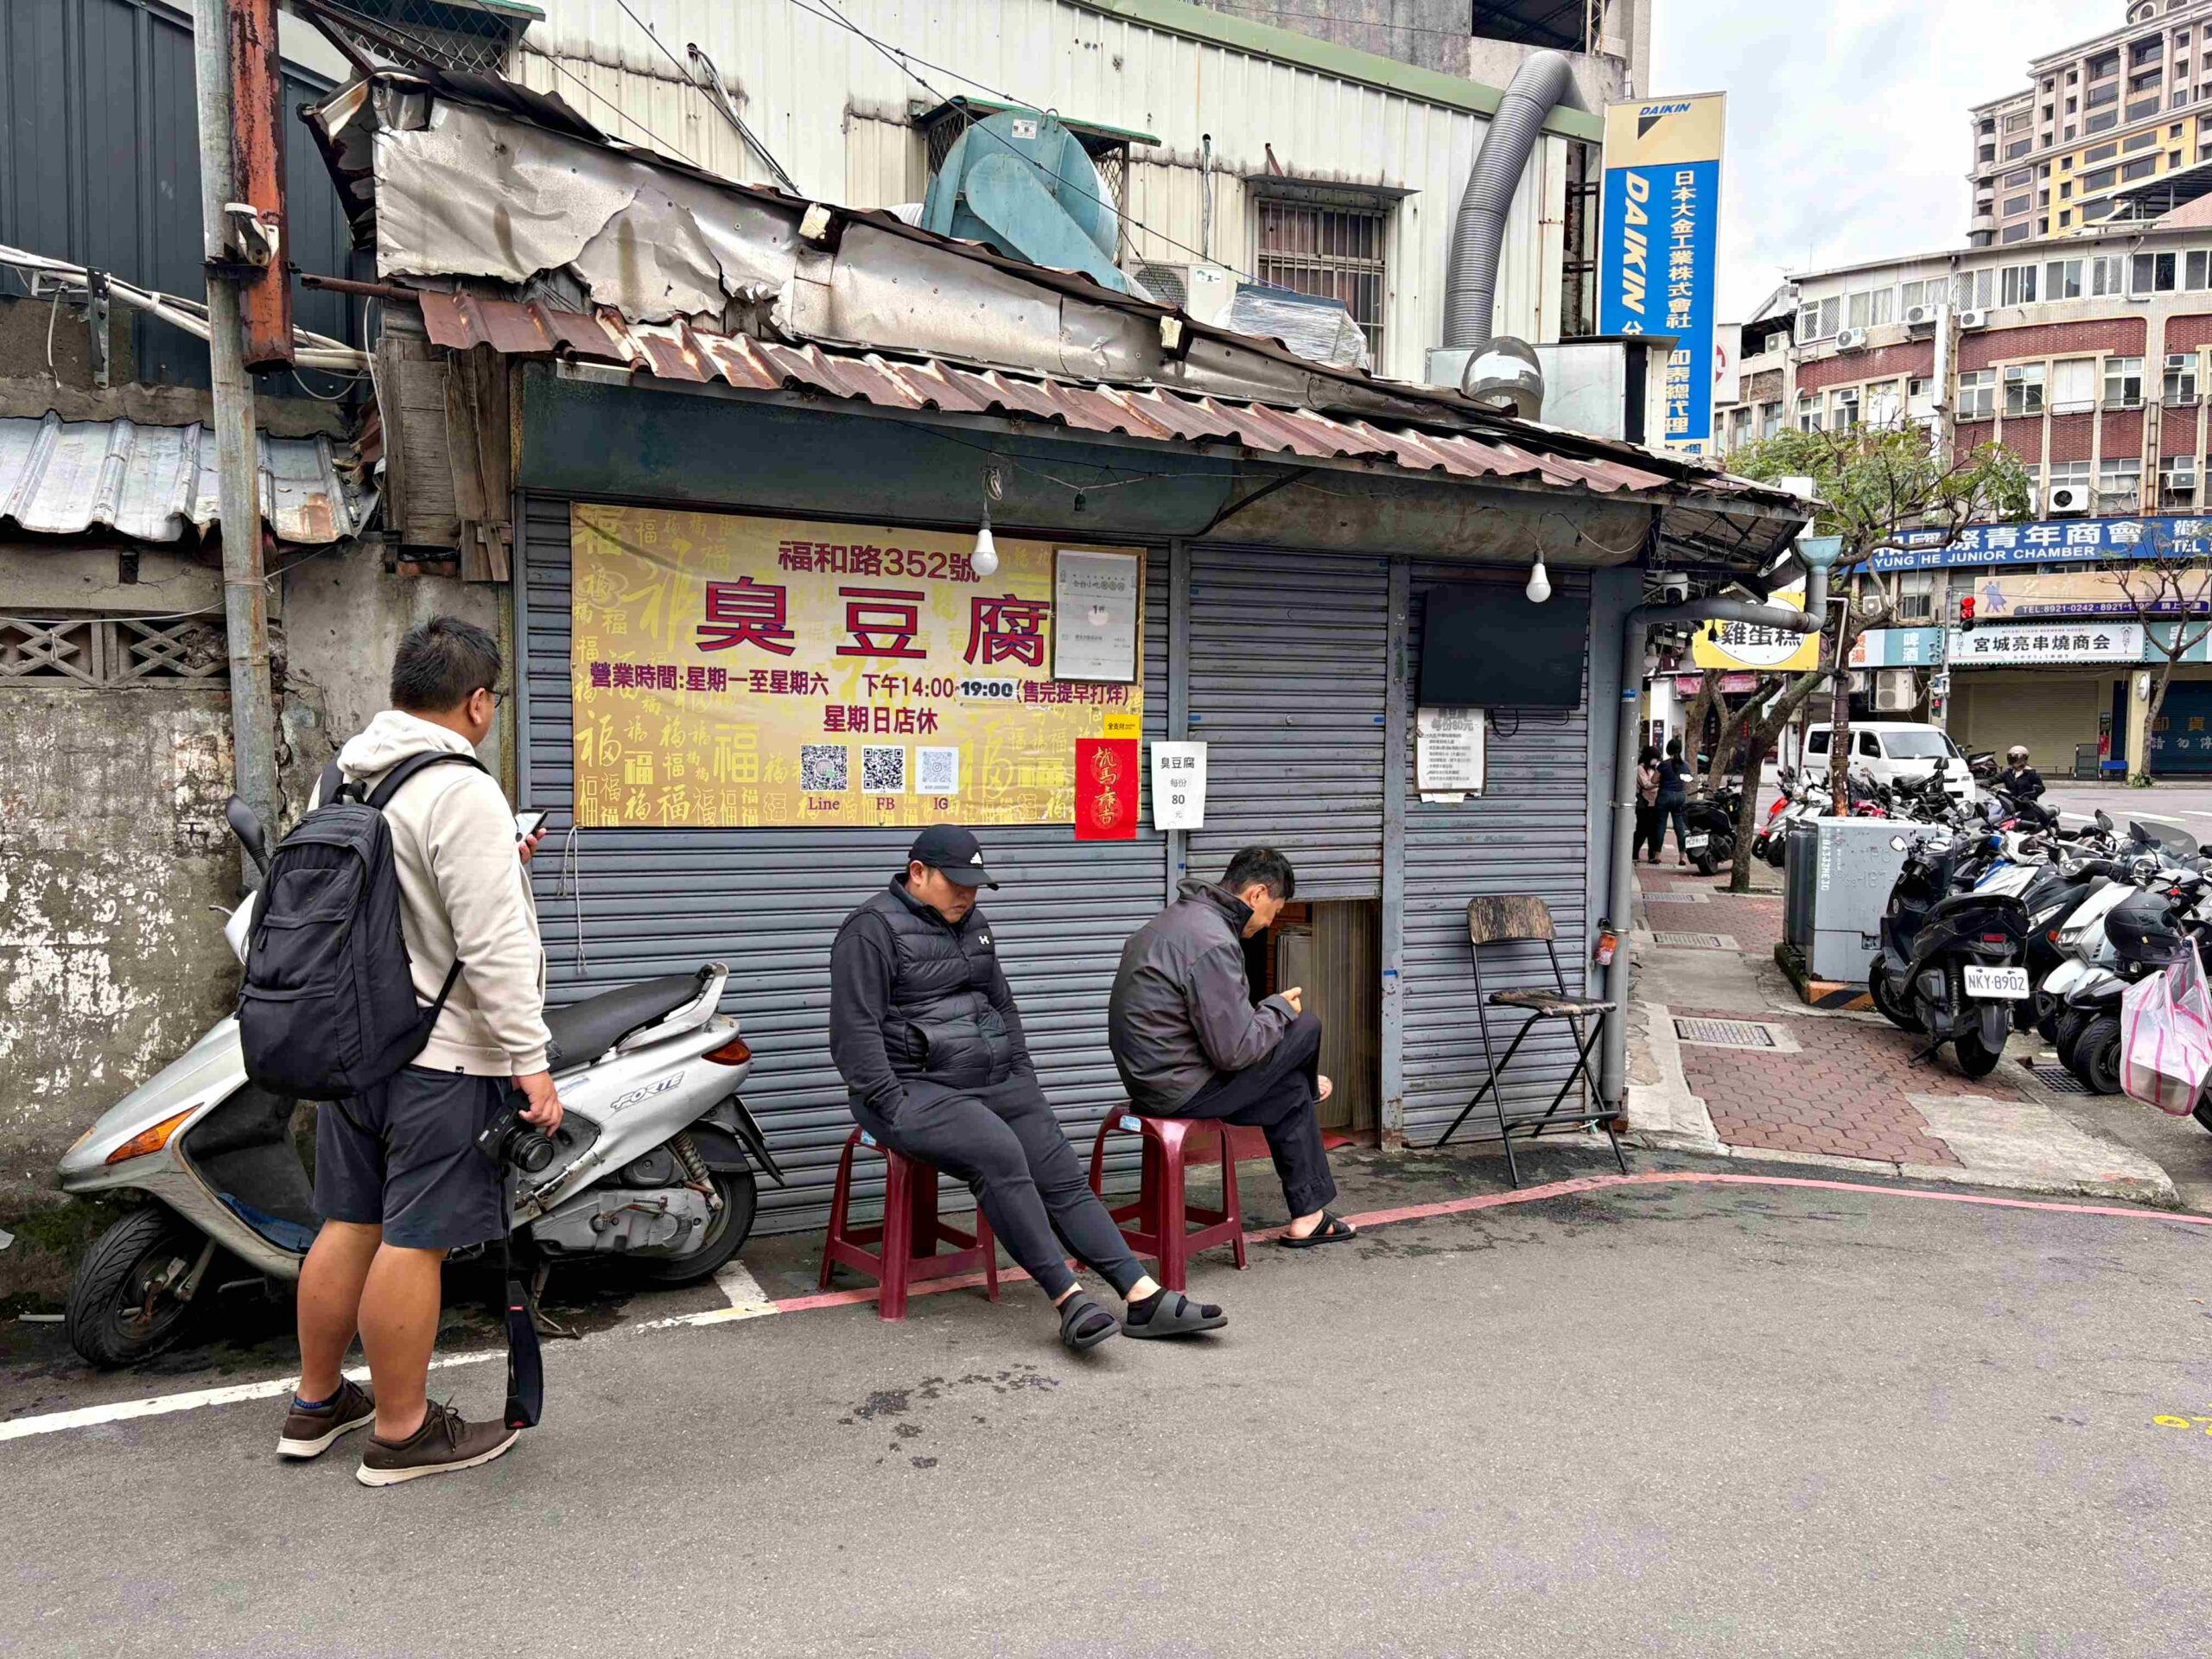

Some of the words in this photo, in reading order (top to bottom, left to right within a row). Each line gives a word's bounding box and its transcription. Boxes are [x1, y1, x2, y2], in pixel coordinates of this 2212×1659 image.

[1638, 102, 1691, 116] DAIKIN
[1622, 170, 1649, 315] DAIKIN
[1666, 169, 1697, 329] 日本大金工業株式會社
[779, 540, 981, 583] 福和路352號
[1874, 556, 1915, 569] YUNG
[1921, 554, 1941, 565] HE
[1948, 550, 2006, 563] JUNIOR
[2013, 545, 2095, 560] CHAMBER
[696, 575, 1051, 667] 臭豆腐
[1720, 621, 1802, 647] 雞蛋糕
[1903, 632, 1919, 662] 啤酒
[590, 661, 829, 696] 營業時間:星期一至星期六
[823, 705, 938, 735] 星期日店休
[1160, 757, 1196, 770] 臭豆腐
[1170, 779, 1187, 788] 每份
[808, 797, 840, 810] Line
[876, 797, 895, 810] FB
[933, 797, 949, 810] IG
[1172, 794, 1185, 804] 80
